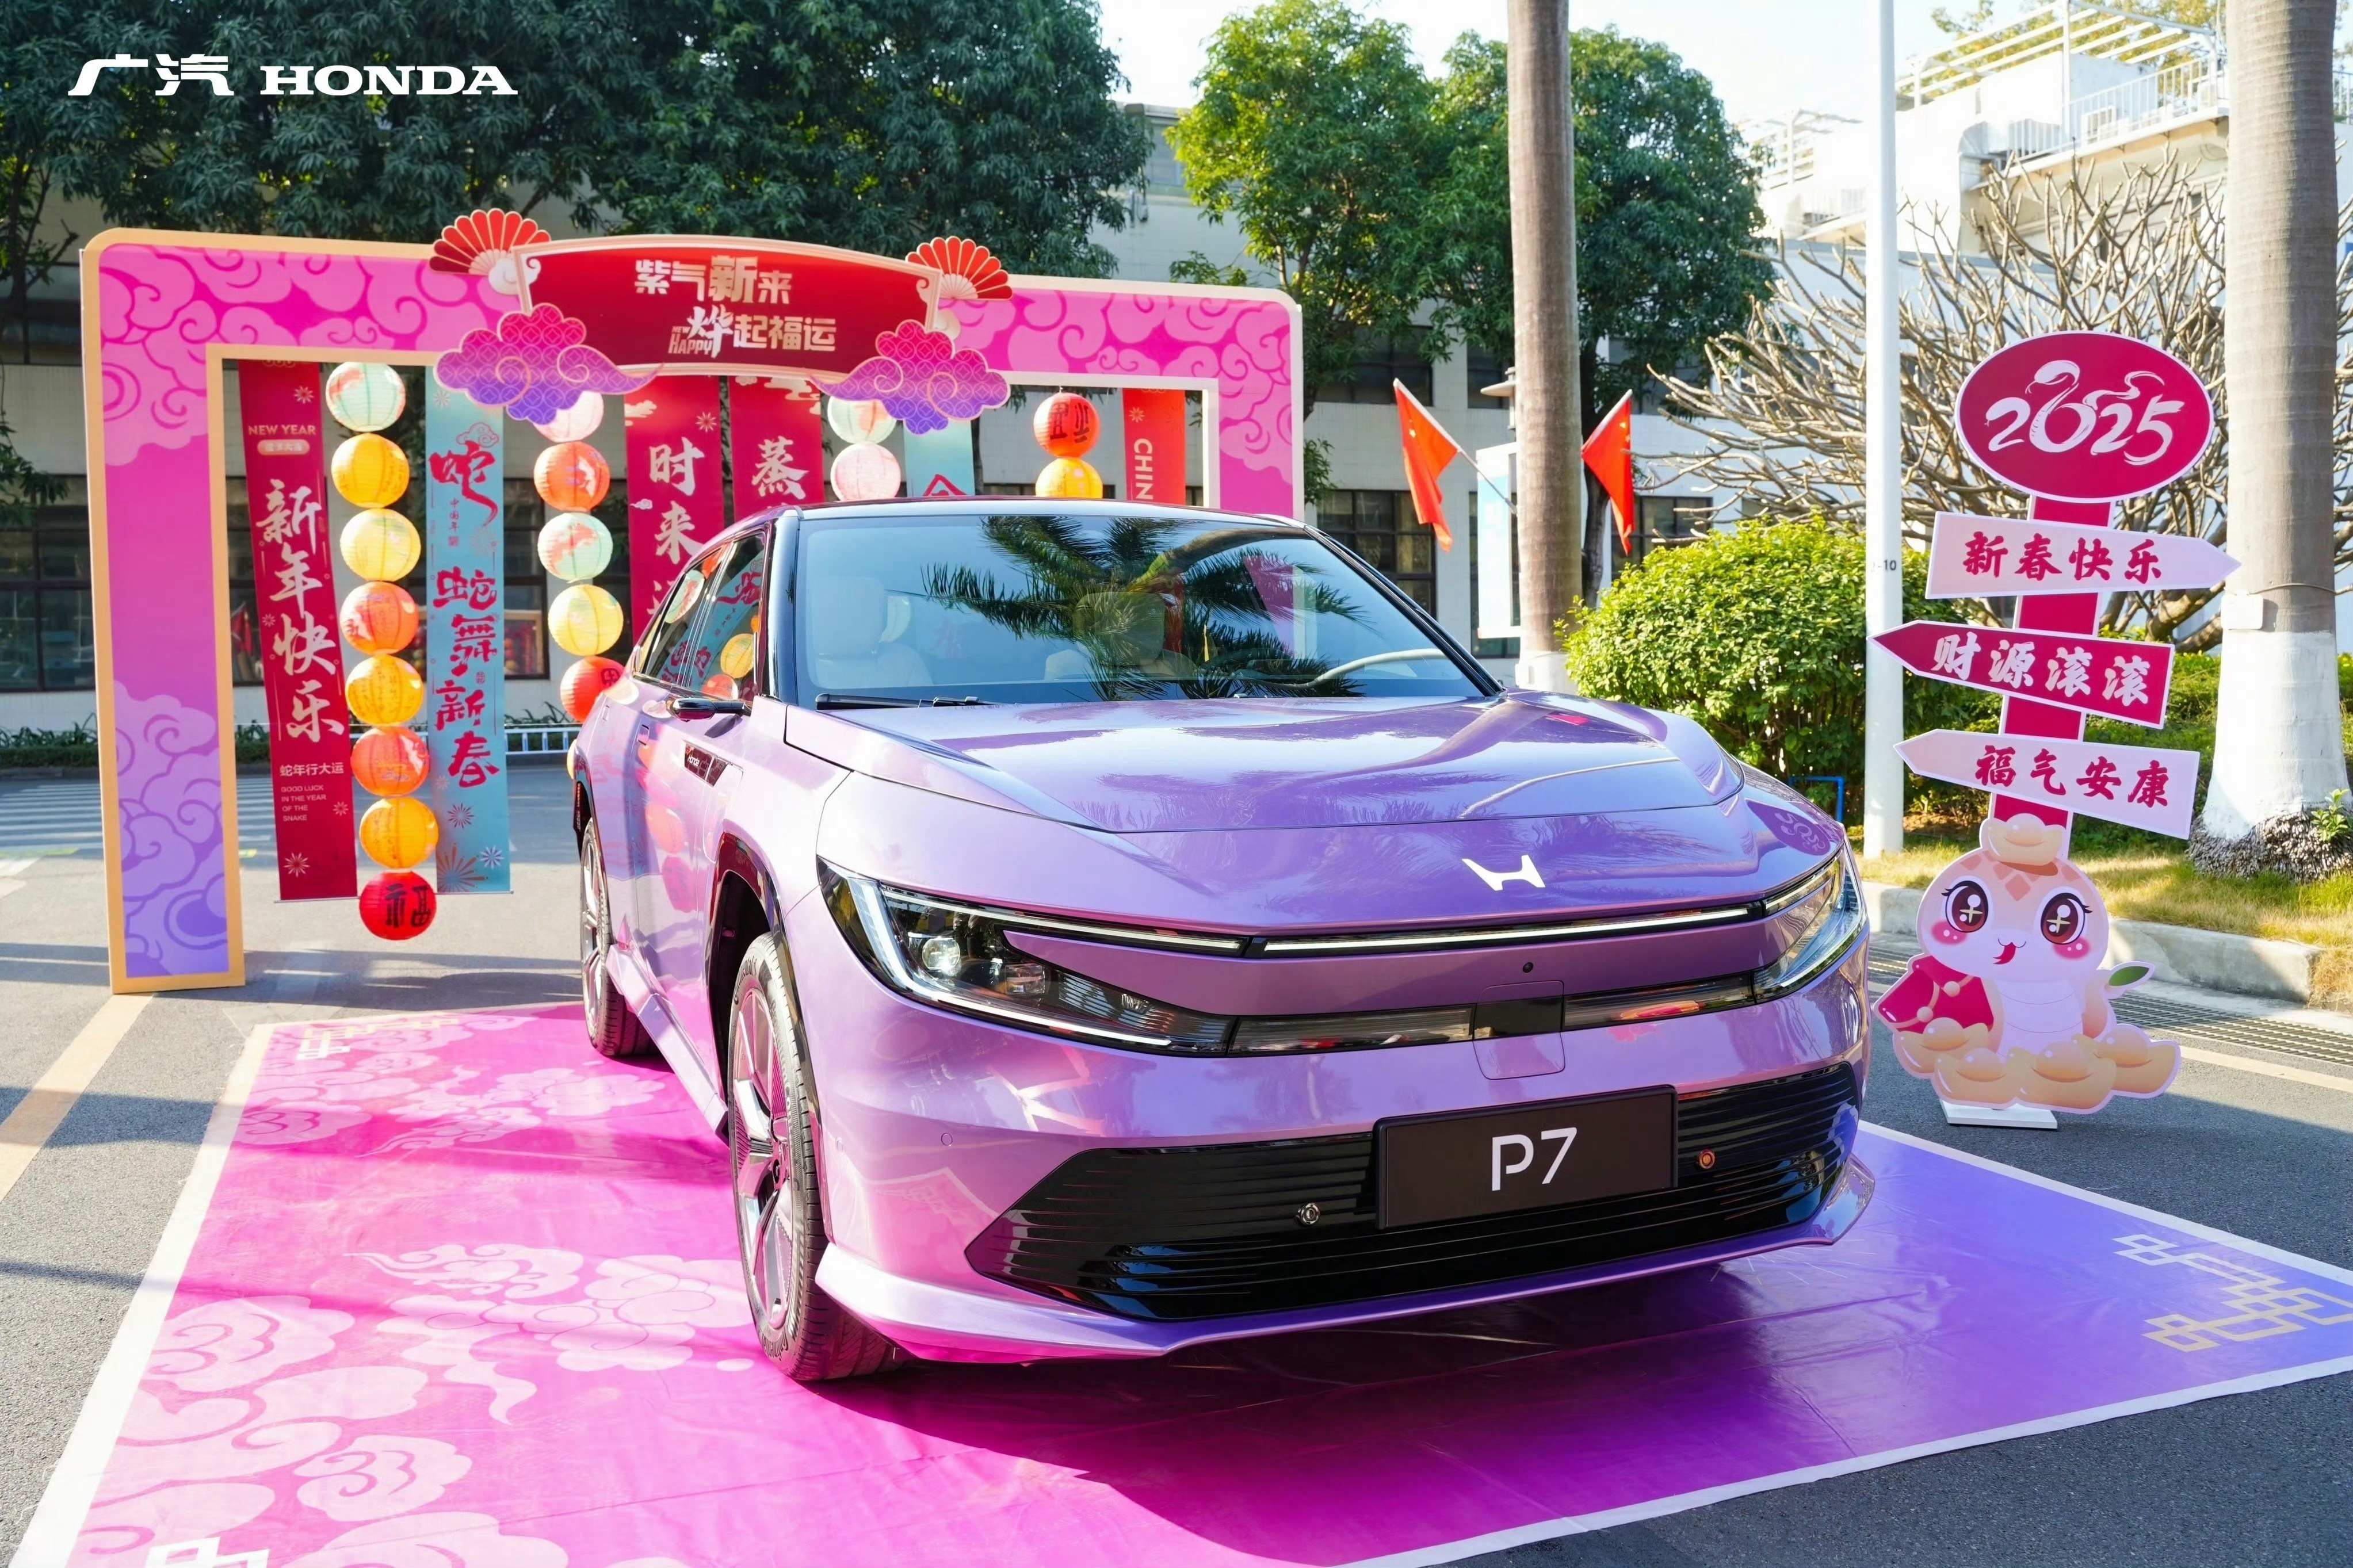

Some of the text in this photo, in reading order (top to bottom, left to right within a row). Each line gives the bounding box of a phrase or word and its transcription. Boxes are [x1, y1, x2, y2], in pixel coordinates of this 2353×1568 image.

[635, 255, 792, 304] 紫气新来
[671, 326, 691, 334] NEW
[686, 304, 837, 359] 烨起福运
[248, 423, 316, 435] NEW YEAR
[1985, 359, 2184, 466] 2025
[751, 435, 809, 505] 蒸
[1133, 438, 1154, 500] CHIN
[647, 437, 705, 615] 时来
[1962, 531, 2162, 583] 新春快乐
[255, 478, 345, 743] 新年快乐
[1933, 631, 2150, 707] 财源滚滚
[280, 762, 344, 776] 蛇年行大运
[1975, 744, 2170, 809] 福气安康
[1492, 1127, 1577, 1191] P7
